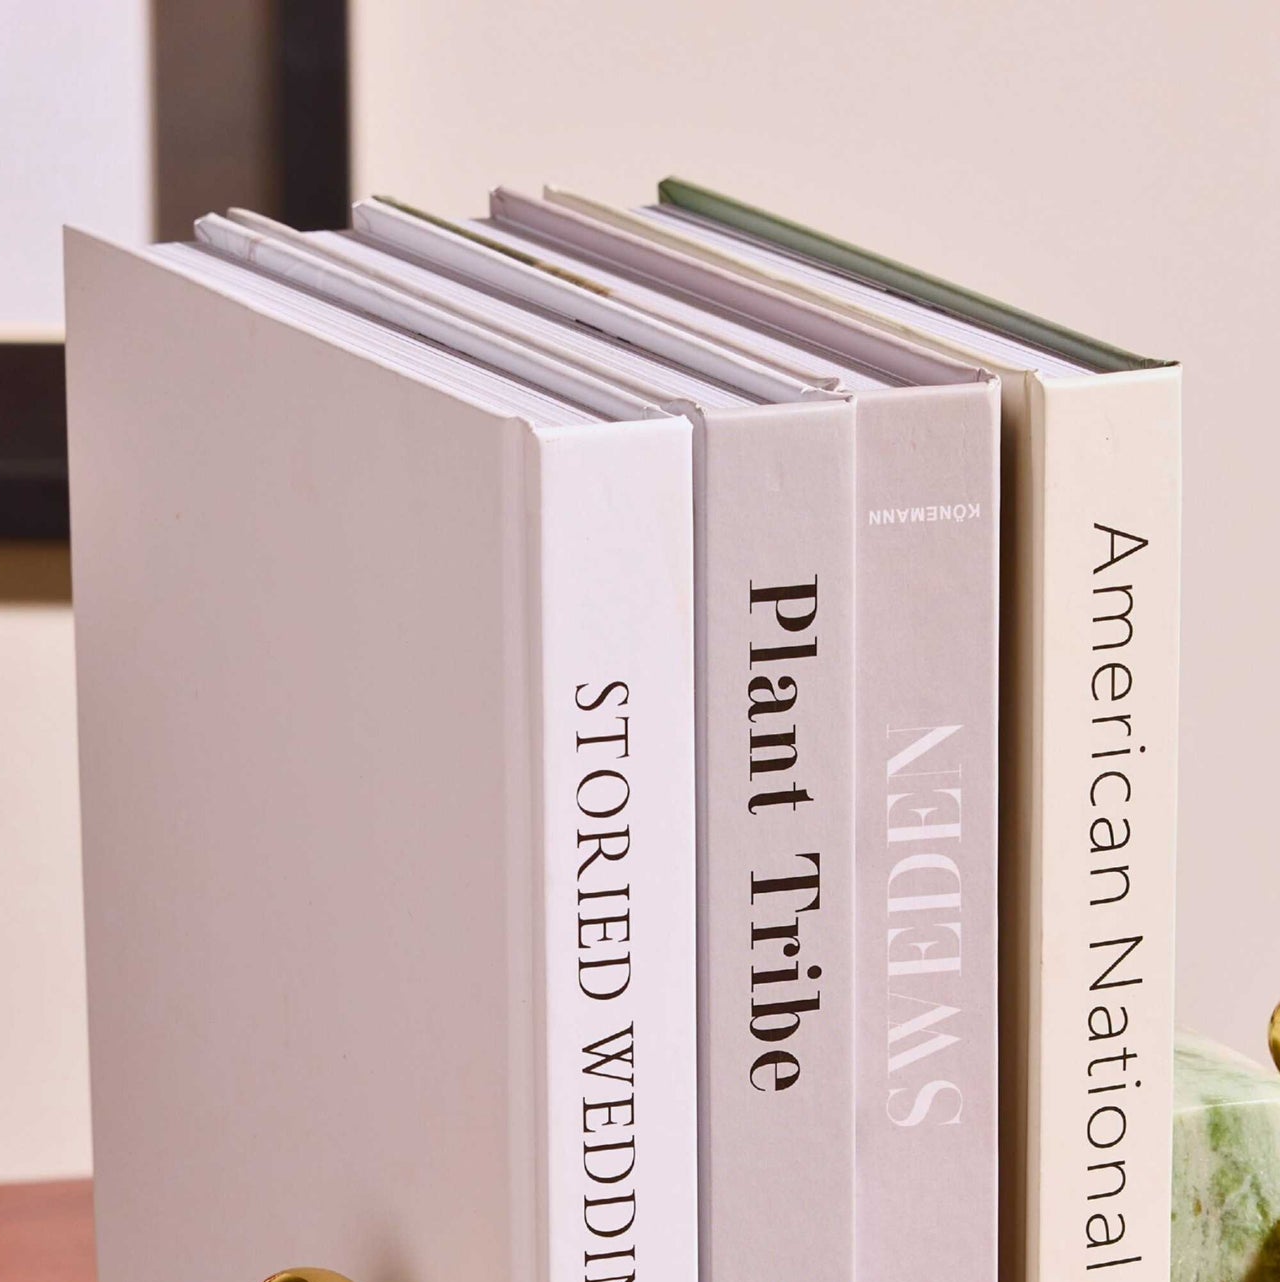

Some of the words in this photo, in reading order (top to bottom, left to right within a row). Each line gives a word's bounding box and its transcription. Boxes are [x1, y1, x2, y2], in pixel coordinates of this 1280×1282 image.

[869, 504, 982, 527] KÖNEMANN
[574, 680, 632, 1001] STORIED
[747, 573, 818, 816] Plant
[1089, 522, 1150, 907] American
[749, 852, 823, 1092] Tribe
[886, 724, 965, 1128] SWEDEN
[1085, 935, 1144, 1271] National
